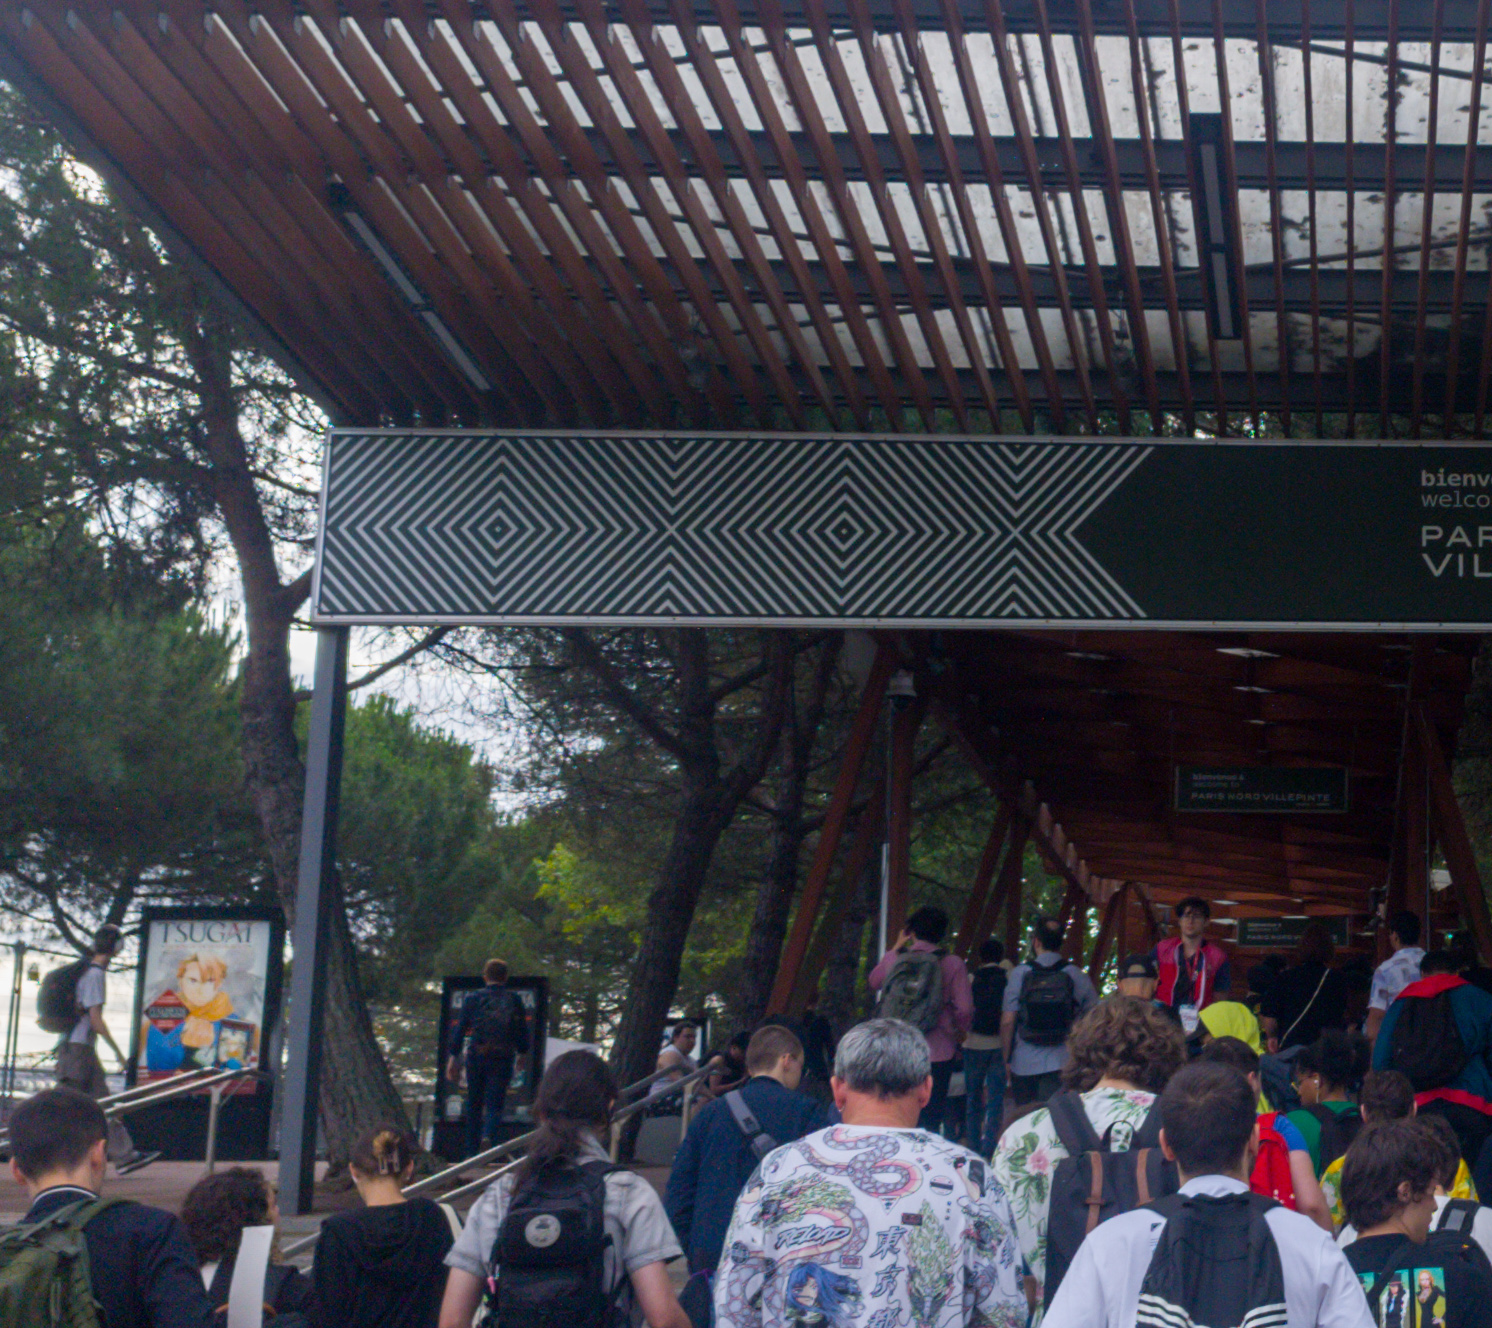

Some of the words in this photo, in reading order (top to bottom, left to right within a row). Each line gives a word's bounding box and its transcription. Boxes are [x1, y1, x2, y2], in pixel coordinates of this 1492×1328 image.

[1191, 792, 1226, 800] PARIS
[1228, 792, 1261, 801] NORD
[1262, 792, 1331, 802] VILLEPINTE
[158, 922, 254, 944] TSUGAI
